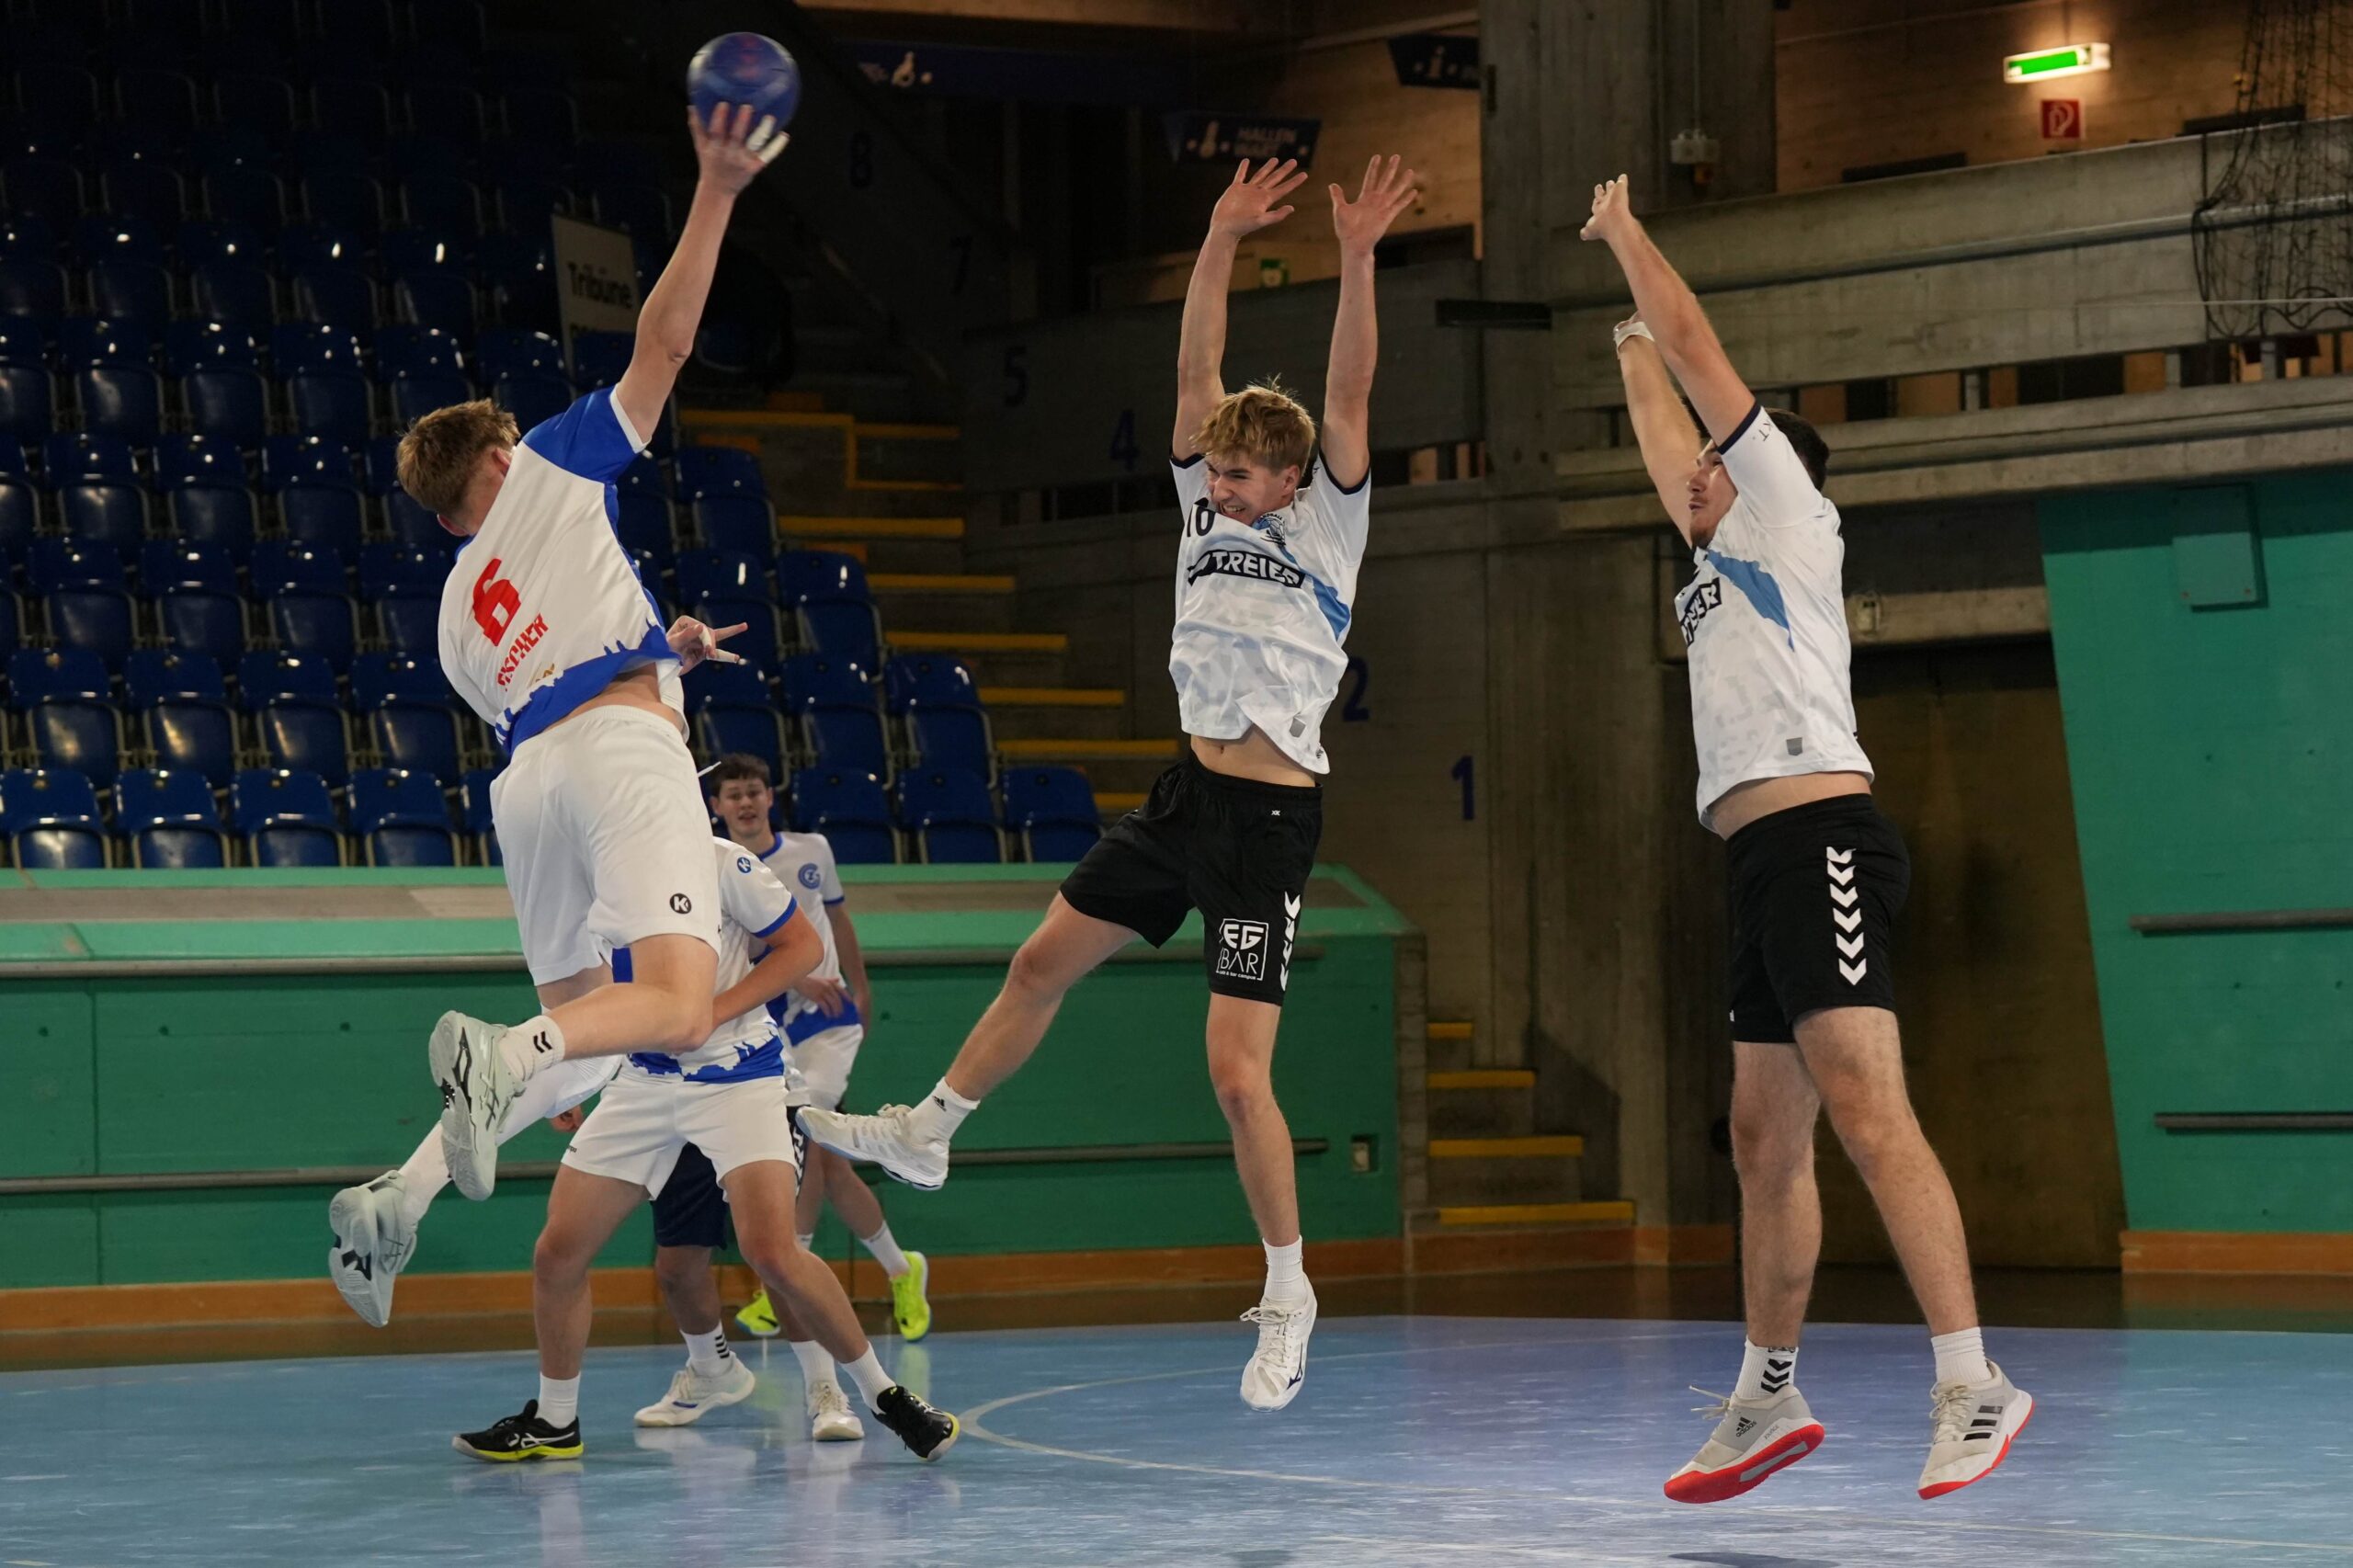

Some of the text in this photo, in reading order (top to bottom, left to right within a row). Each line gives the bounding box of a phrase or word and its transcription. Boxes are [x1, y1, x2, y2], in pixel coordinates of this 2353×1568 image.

[850, 131, 872, 187] 8
[567, 261, 633, 309] Tribüne
[950, 235, 972, 295] 7
[1005, 346, 1028, 405] 5
[1109, 410, 1140, 471] 4
[1211, 551, 1301, 585] TREIER
[472, 558, 522, 647] 6
[1343, 656, 1370, 722] 2
[1452, 756, 1474, 820] 1
[1220, 948, 1257, 974] BAR
[1735, 1420, 1757, 1437] adidas
